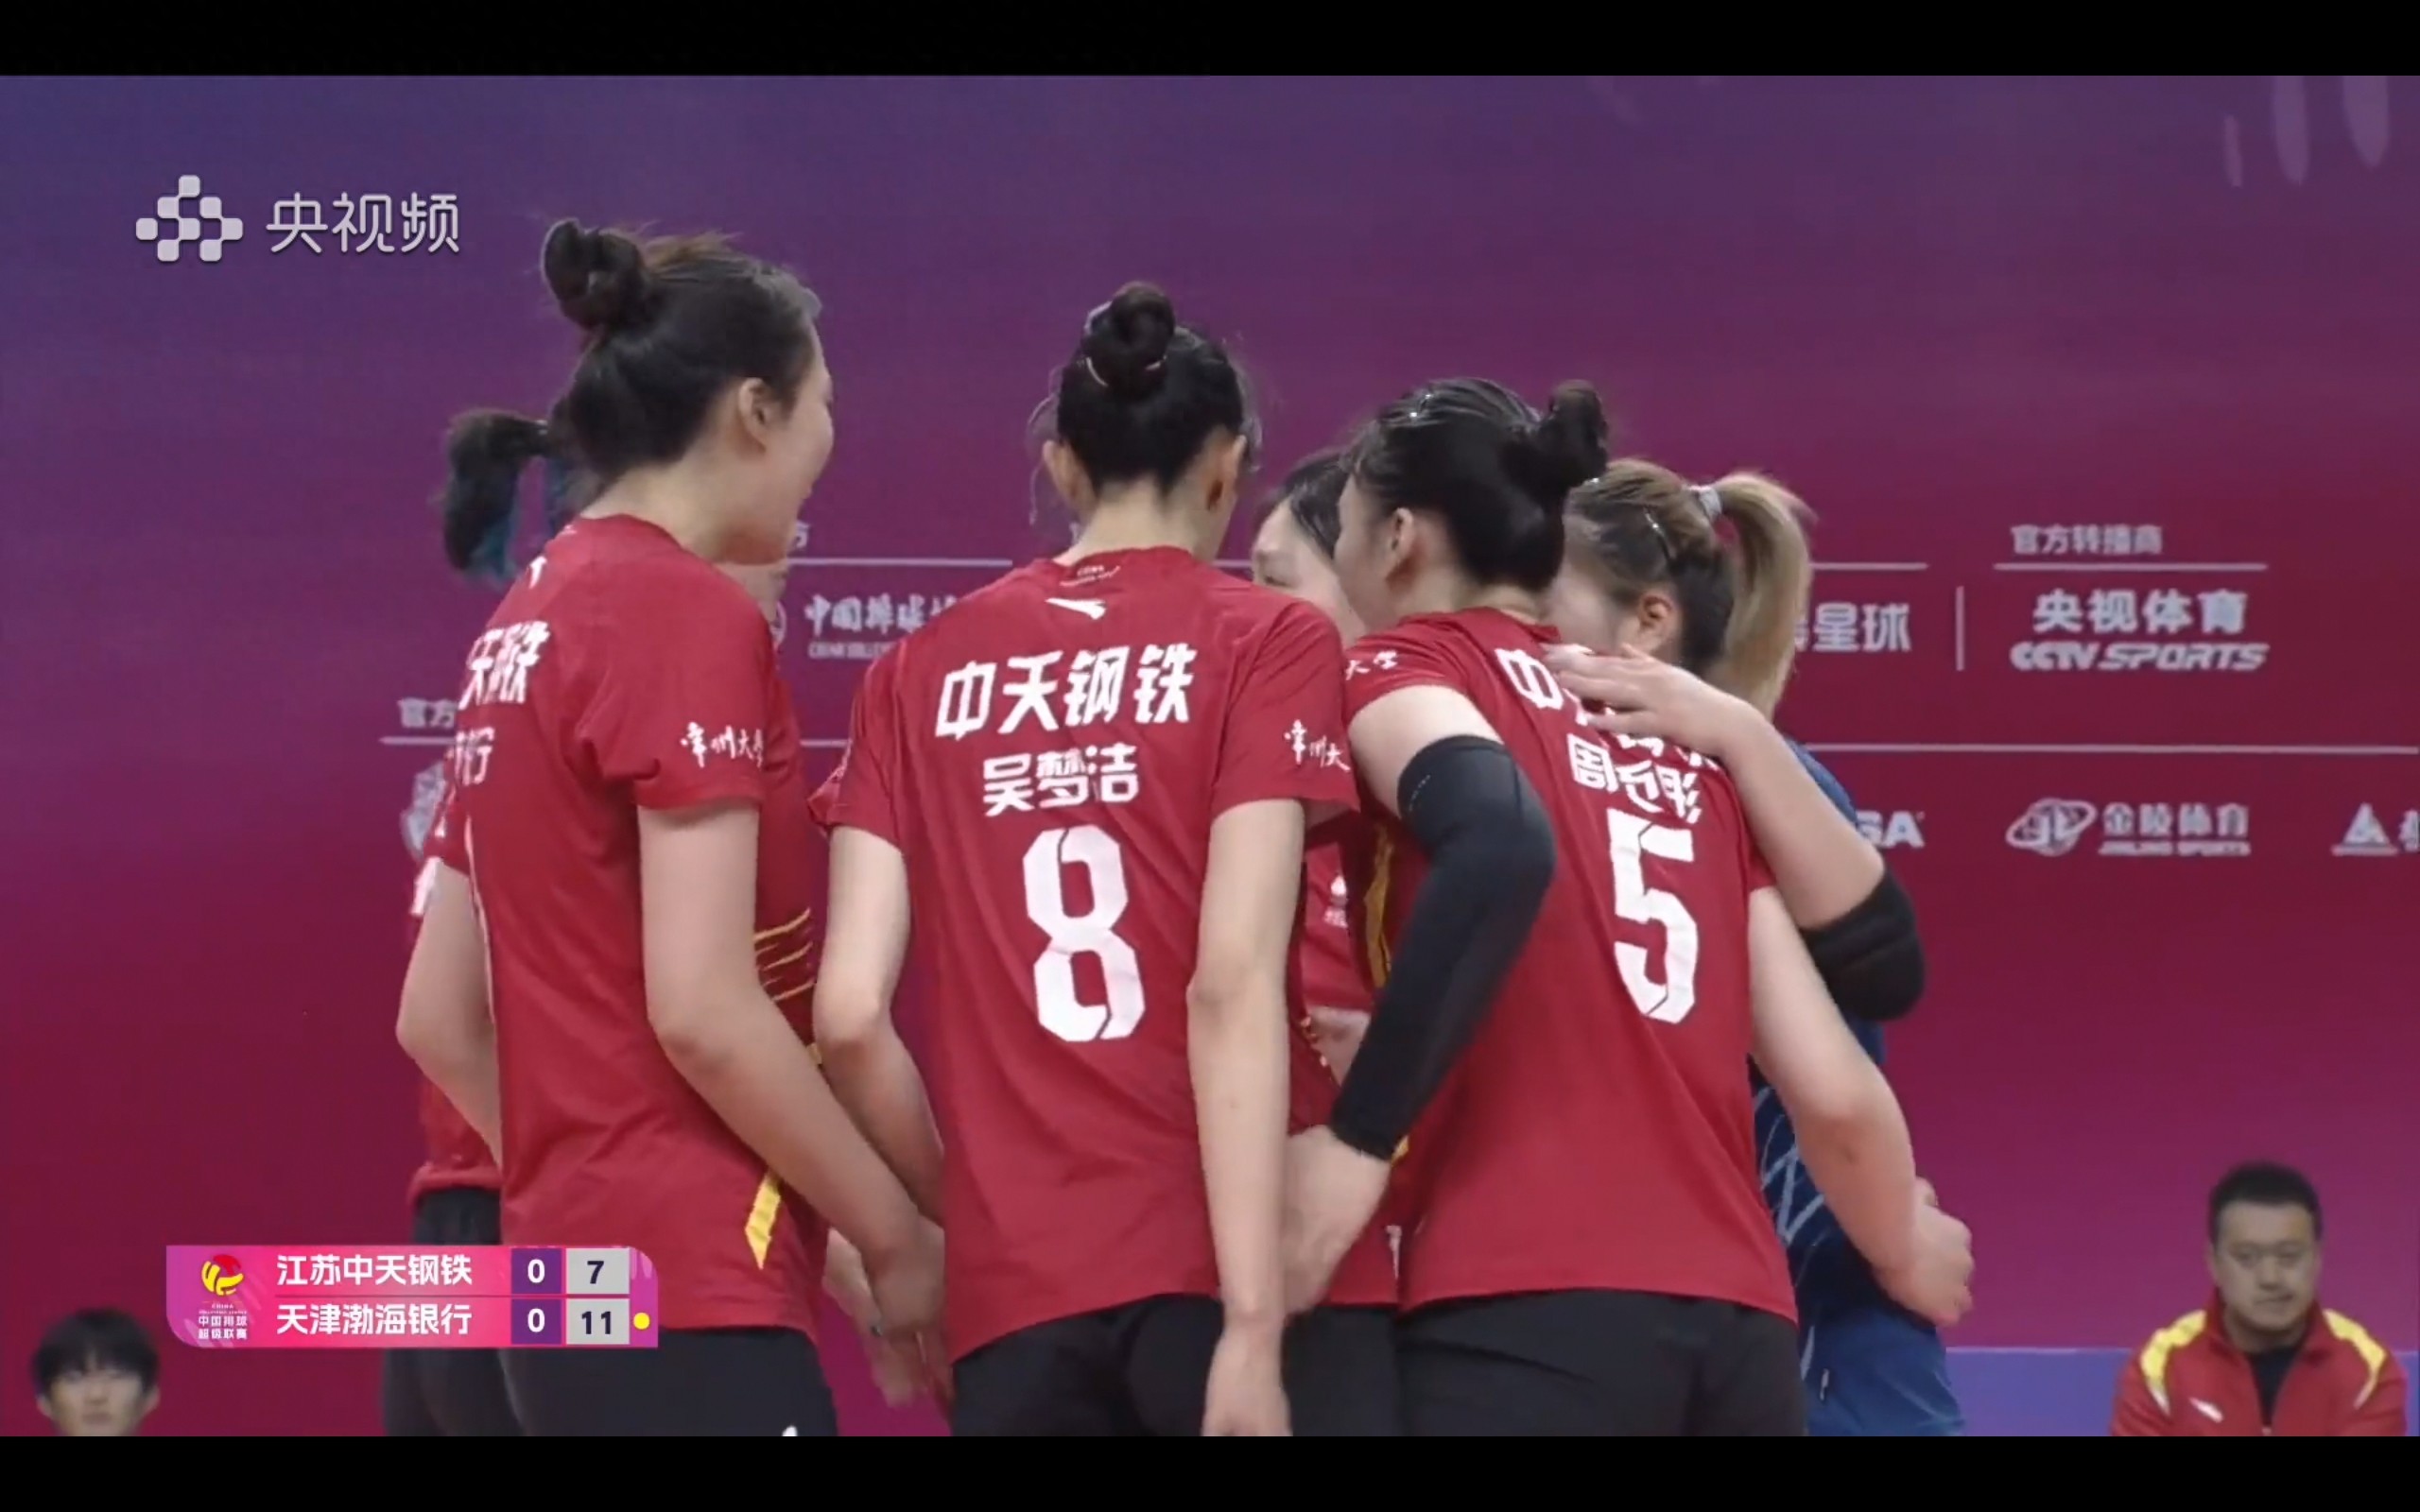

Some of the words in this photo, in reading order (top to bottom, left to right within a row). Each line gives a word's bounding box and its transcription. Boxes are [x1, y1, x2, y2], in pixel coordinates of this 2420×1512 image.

[2010, 524, 2163, 556] 官方转播商
[1795, 602, 1911, 653] 星球
[2033, 588, 2248, 634] 央视体育
[2010, 641, 2100, 671] CCTV
[2098, 642, 2270, 671] SPORTS
[935, 643, 1198, 741] 中天钢铁
[983, 743, 1139, 817] 吴梦洁
[2102, 802, 2249, 837] 金陵体育
[1023, 824, 1146, 1042] 8
[1606, 807, 1699, 1024] 5
